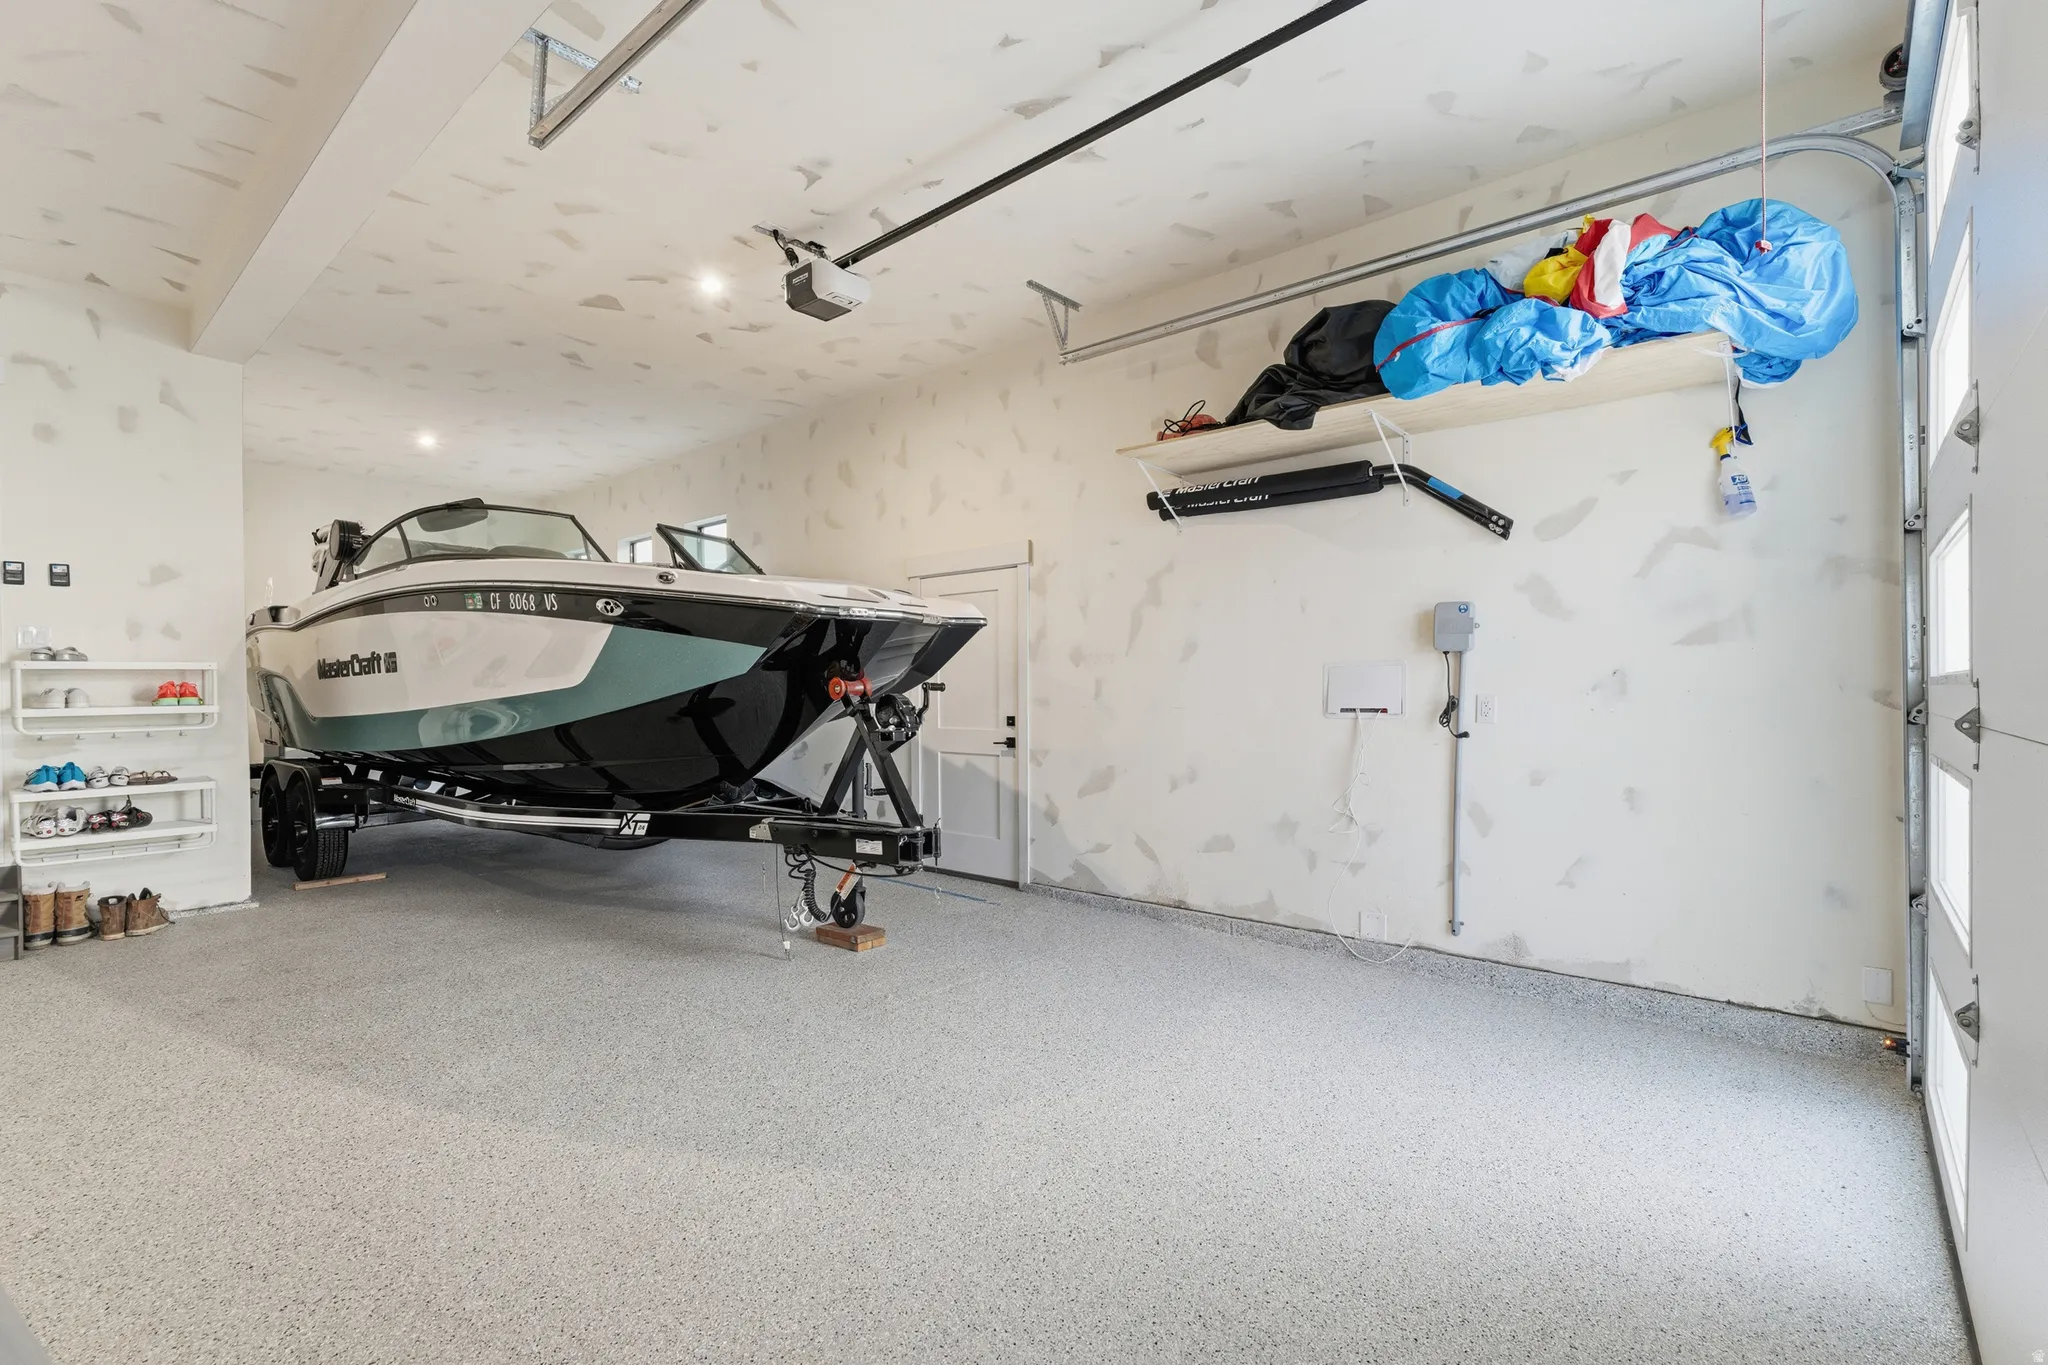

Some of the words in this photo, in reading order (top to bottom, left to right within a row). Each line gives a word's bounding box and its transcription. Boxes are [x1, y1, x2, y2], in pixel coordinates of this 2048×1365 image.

[490, 592, 501, 610] CF
[509, 592, 536, 612] 8068
[544, 592, 559, 611] VS
[317, 650, 382, 680] MasterCraft
[619, 811, 651, 836] XT
